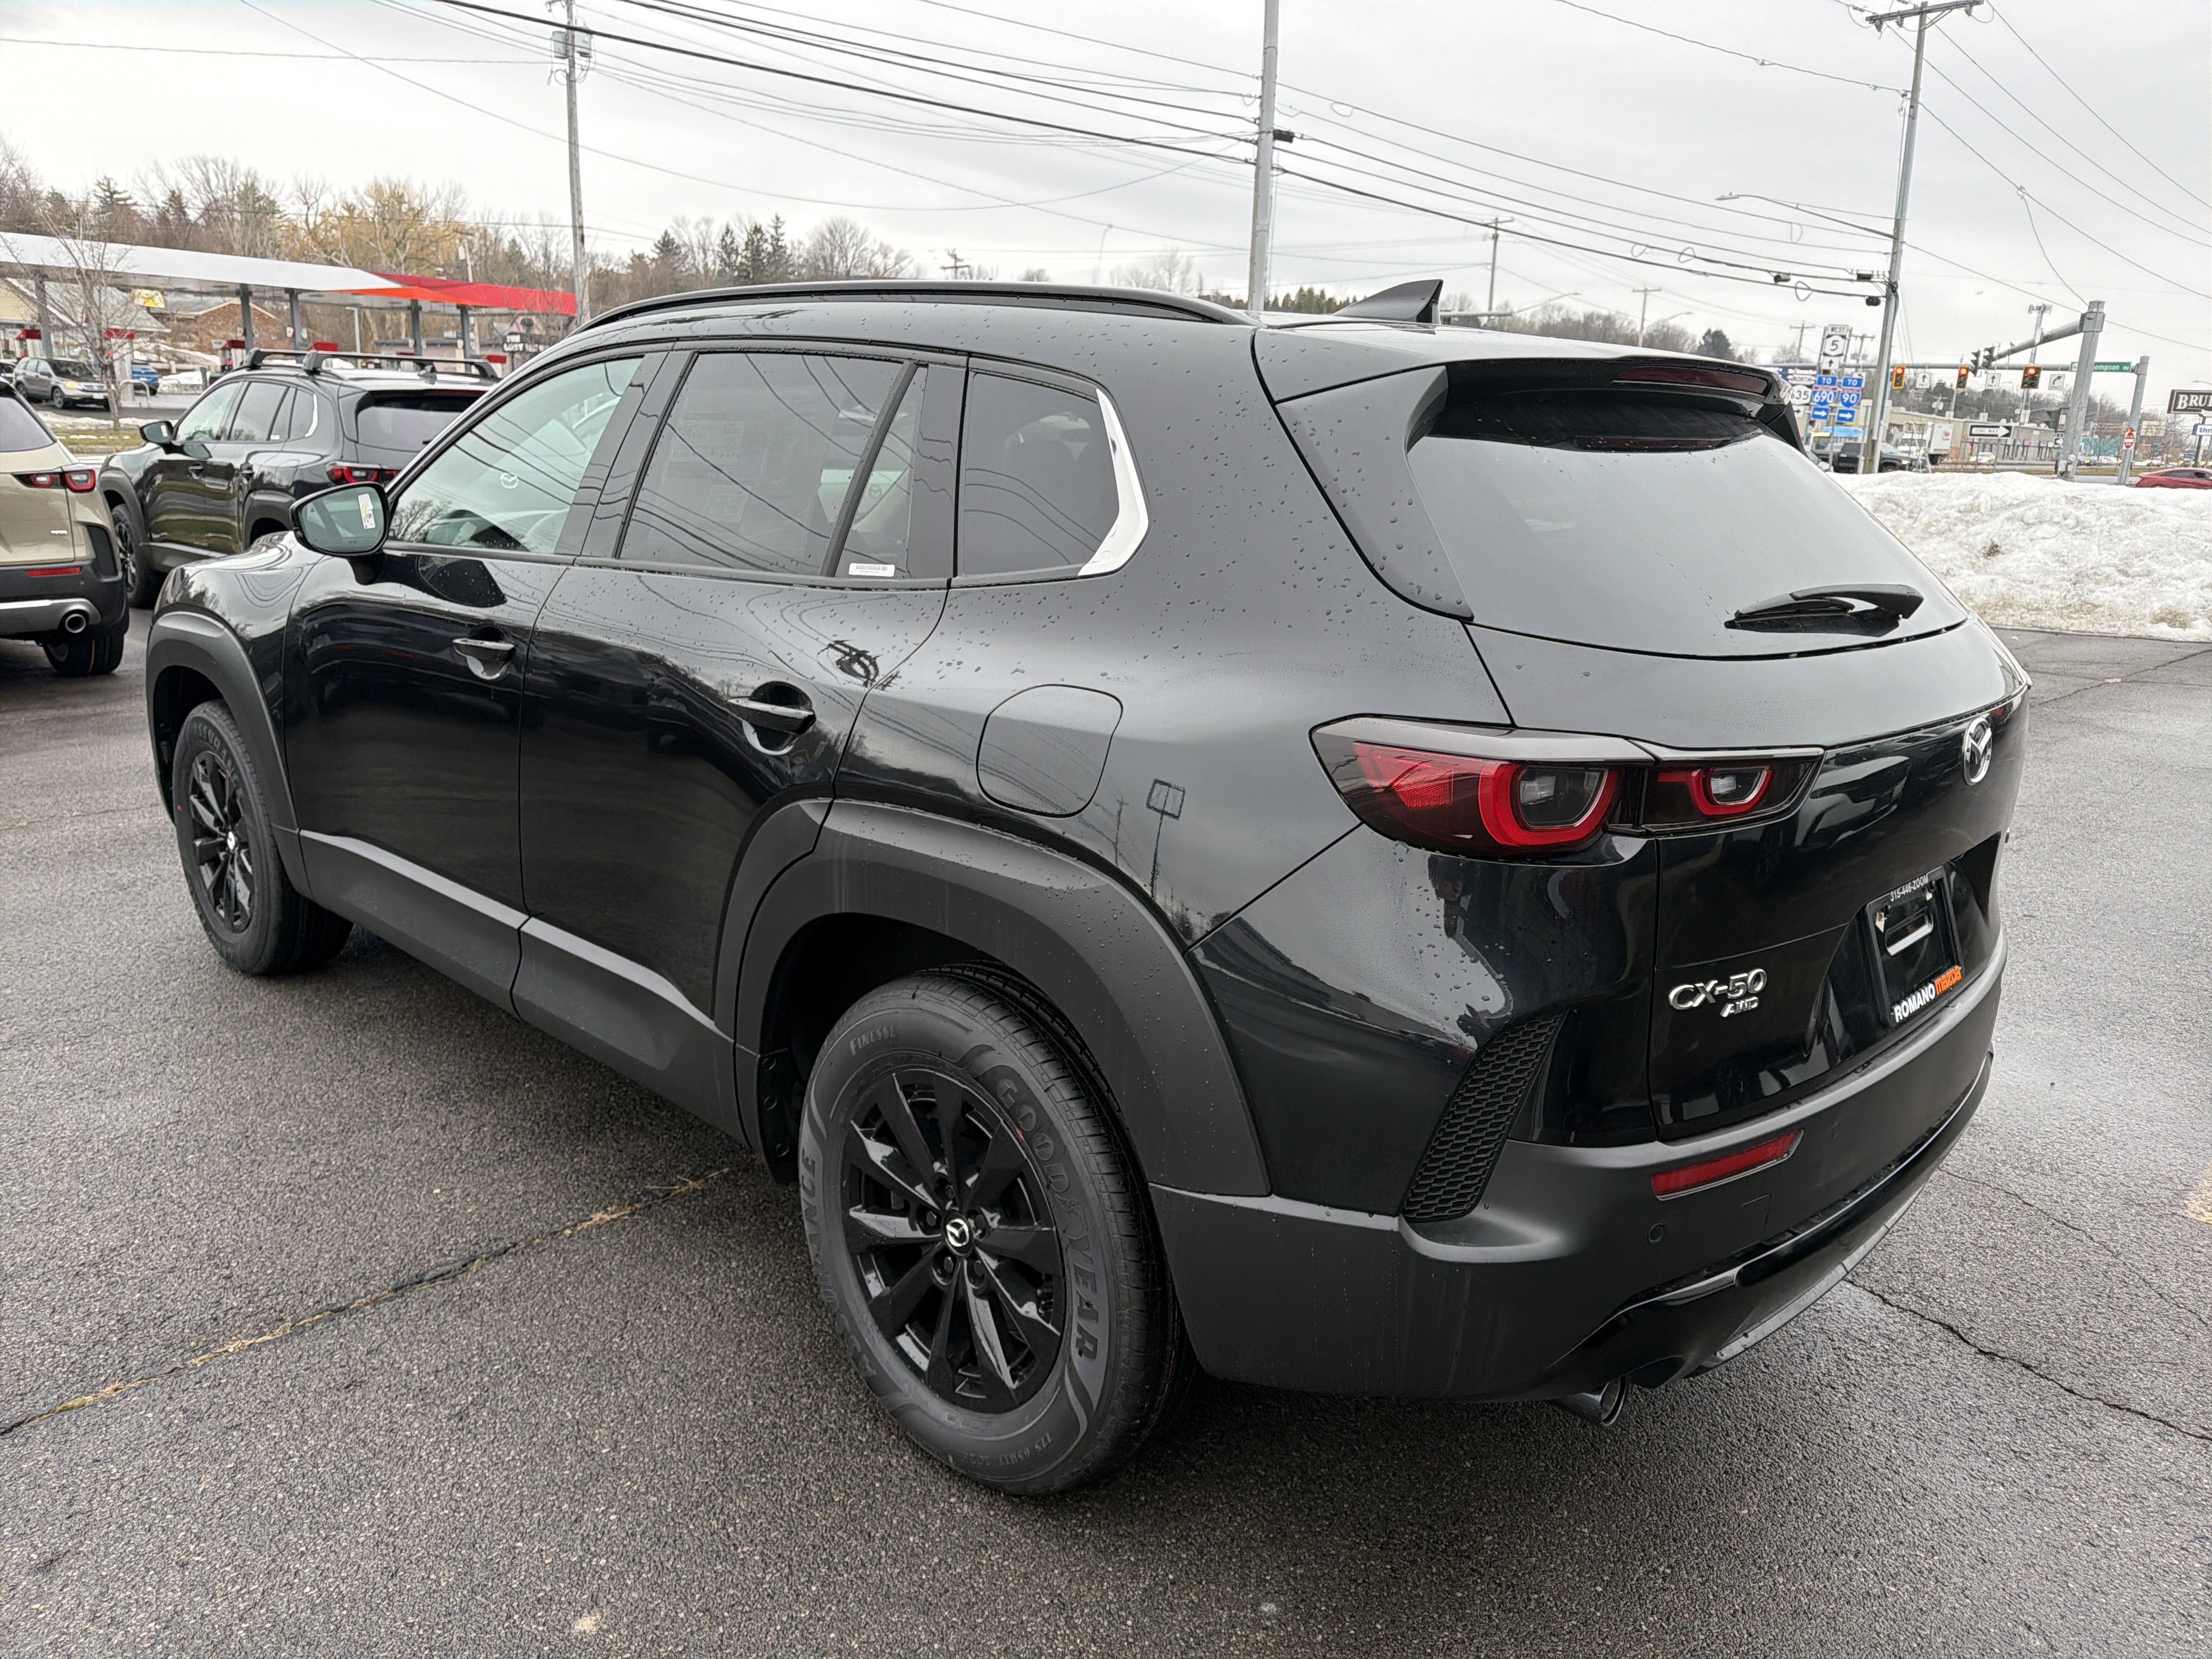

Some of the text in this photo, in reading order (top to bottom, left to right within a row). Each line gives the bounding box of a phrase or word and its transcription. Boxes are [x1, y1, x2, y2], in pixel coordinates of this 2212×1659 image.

[1830, 340, 1839, 352] 5
[1791, 388, 1809, 400] 635
[1814, 391, 1835, 403] 690
[1842, 392, 1858, 402] 90
[1890, 874, 1929, 902] 315-446-ZOOM
[1668, 968, 1768, 1010] CX-50
[1893, 983, 1936, 1023] ROMANO
[1720, 996, 1759, 1018] AWD
[849, 1025, 897, 1057] FINESSE
[995, 1077, 1099, 1363] GOODYEAR
[801, 1147, 877, 1378] ASSURANCE
